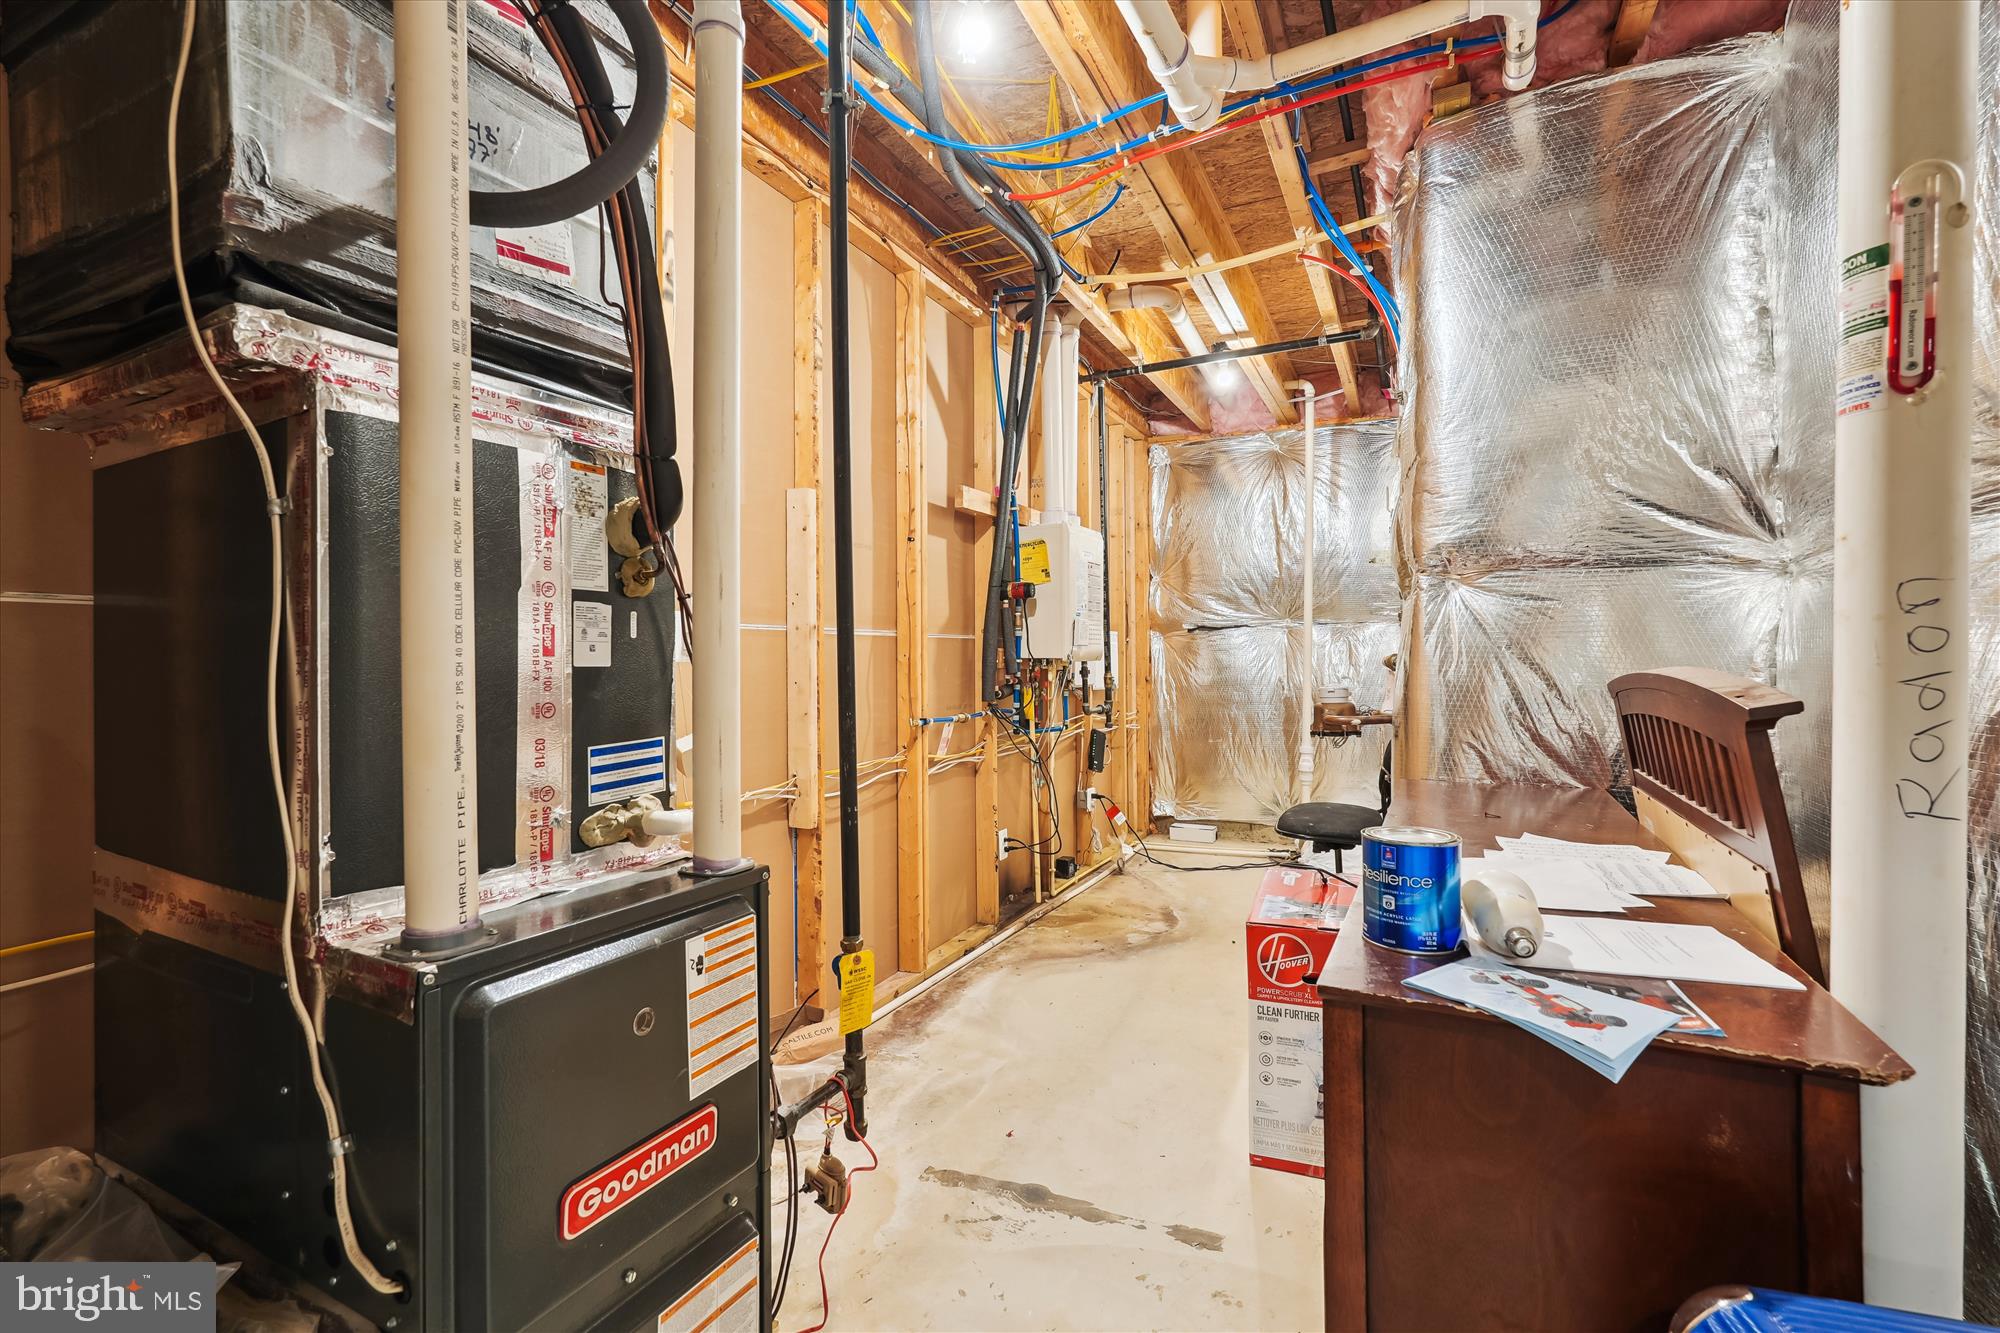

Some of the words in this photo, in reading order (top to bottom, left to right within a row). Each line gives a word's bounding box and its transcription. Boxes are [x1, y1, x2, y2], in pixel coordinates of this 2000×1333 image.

[450, 138, 459, 150] IN
[450, 152, 459, 174] MADE
[451, 319, 460, 335] FOR
[451, 339, 460, 353] NOT
[452, 362, 461, 391] 891-16
[453, 403, 461, 424] ASTM
[453, 496, 461, 516] PIPE
[453, 558, 462, 577] CORE
[544, 556, 553, 572] 100
[454, 581, 463, 620] CELLULAR
[532, 602, 542, 634] 181A-P
[542, 602, 556, 650] Shurtape
[455, 624, 463, 644] COEX
[455, 647, 464, 658] 40
[455, 662, 464, 677] SCH
[532, 644, 541, 682] 181B-FX
[543, 660, 553, 671] AF
[543, 676, 554, 692] 100
[1896, 577, 1960, 821] Radon
[455, 714, 464, 733] 4200
[534, 737, 547, 769] 03/18
[456, 790, 467, 829] PIPE
[457, 838, 468, 925] CHARLOTTE
[1304, 992, 1313, 1000] XL
[1257, 1004, 1282, 1019] CLEAN
[1284, 1008, 1320, 1022] FURTHER
[578, 1124, 709, 1218] Goodman
